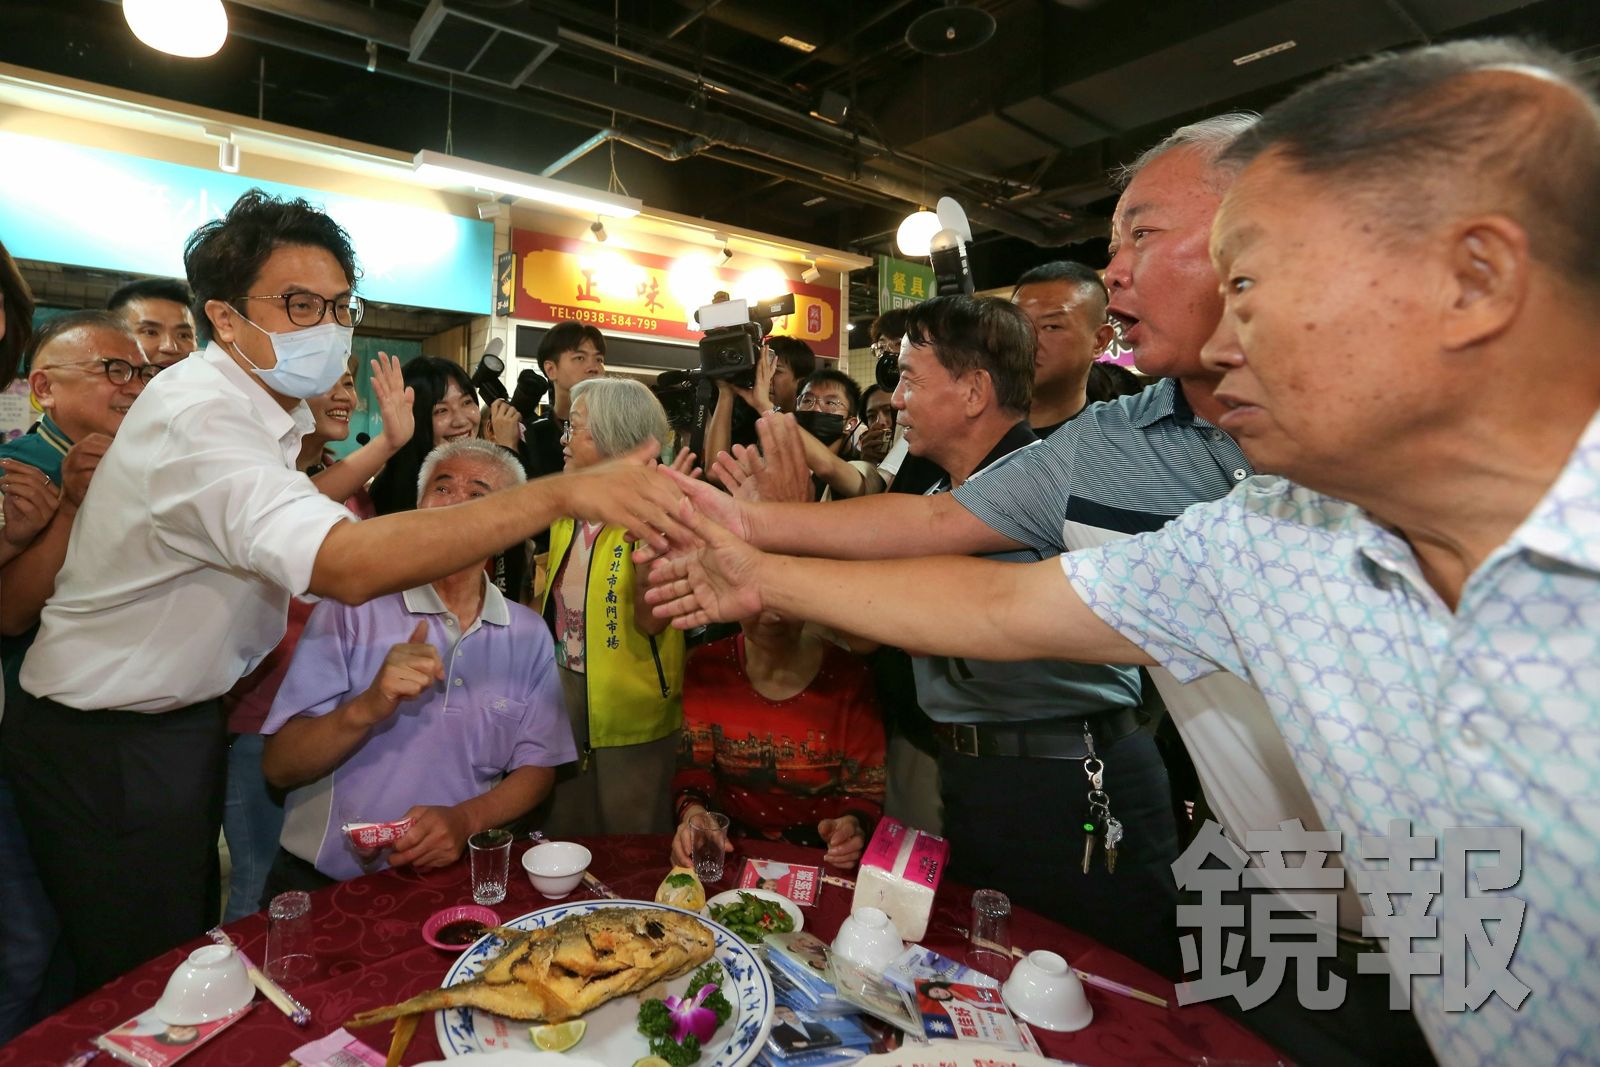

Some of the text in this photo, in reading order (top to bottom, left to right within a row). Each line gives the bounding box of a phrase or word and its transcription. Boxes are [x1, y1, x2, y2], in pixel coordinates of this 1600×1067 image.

[892, 271, 925, 298] 餐具
[550, 306, 657, 330] TEL:0938-584-799
[605, 545, 623, 650] 台北市南門市場
